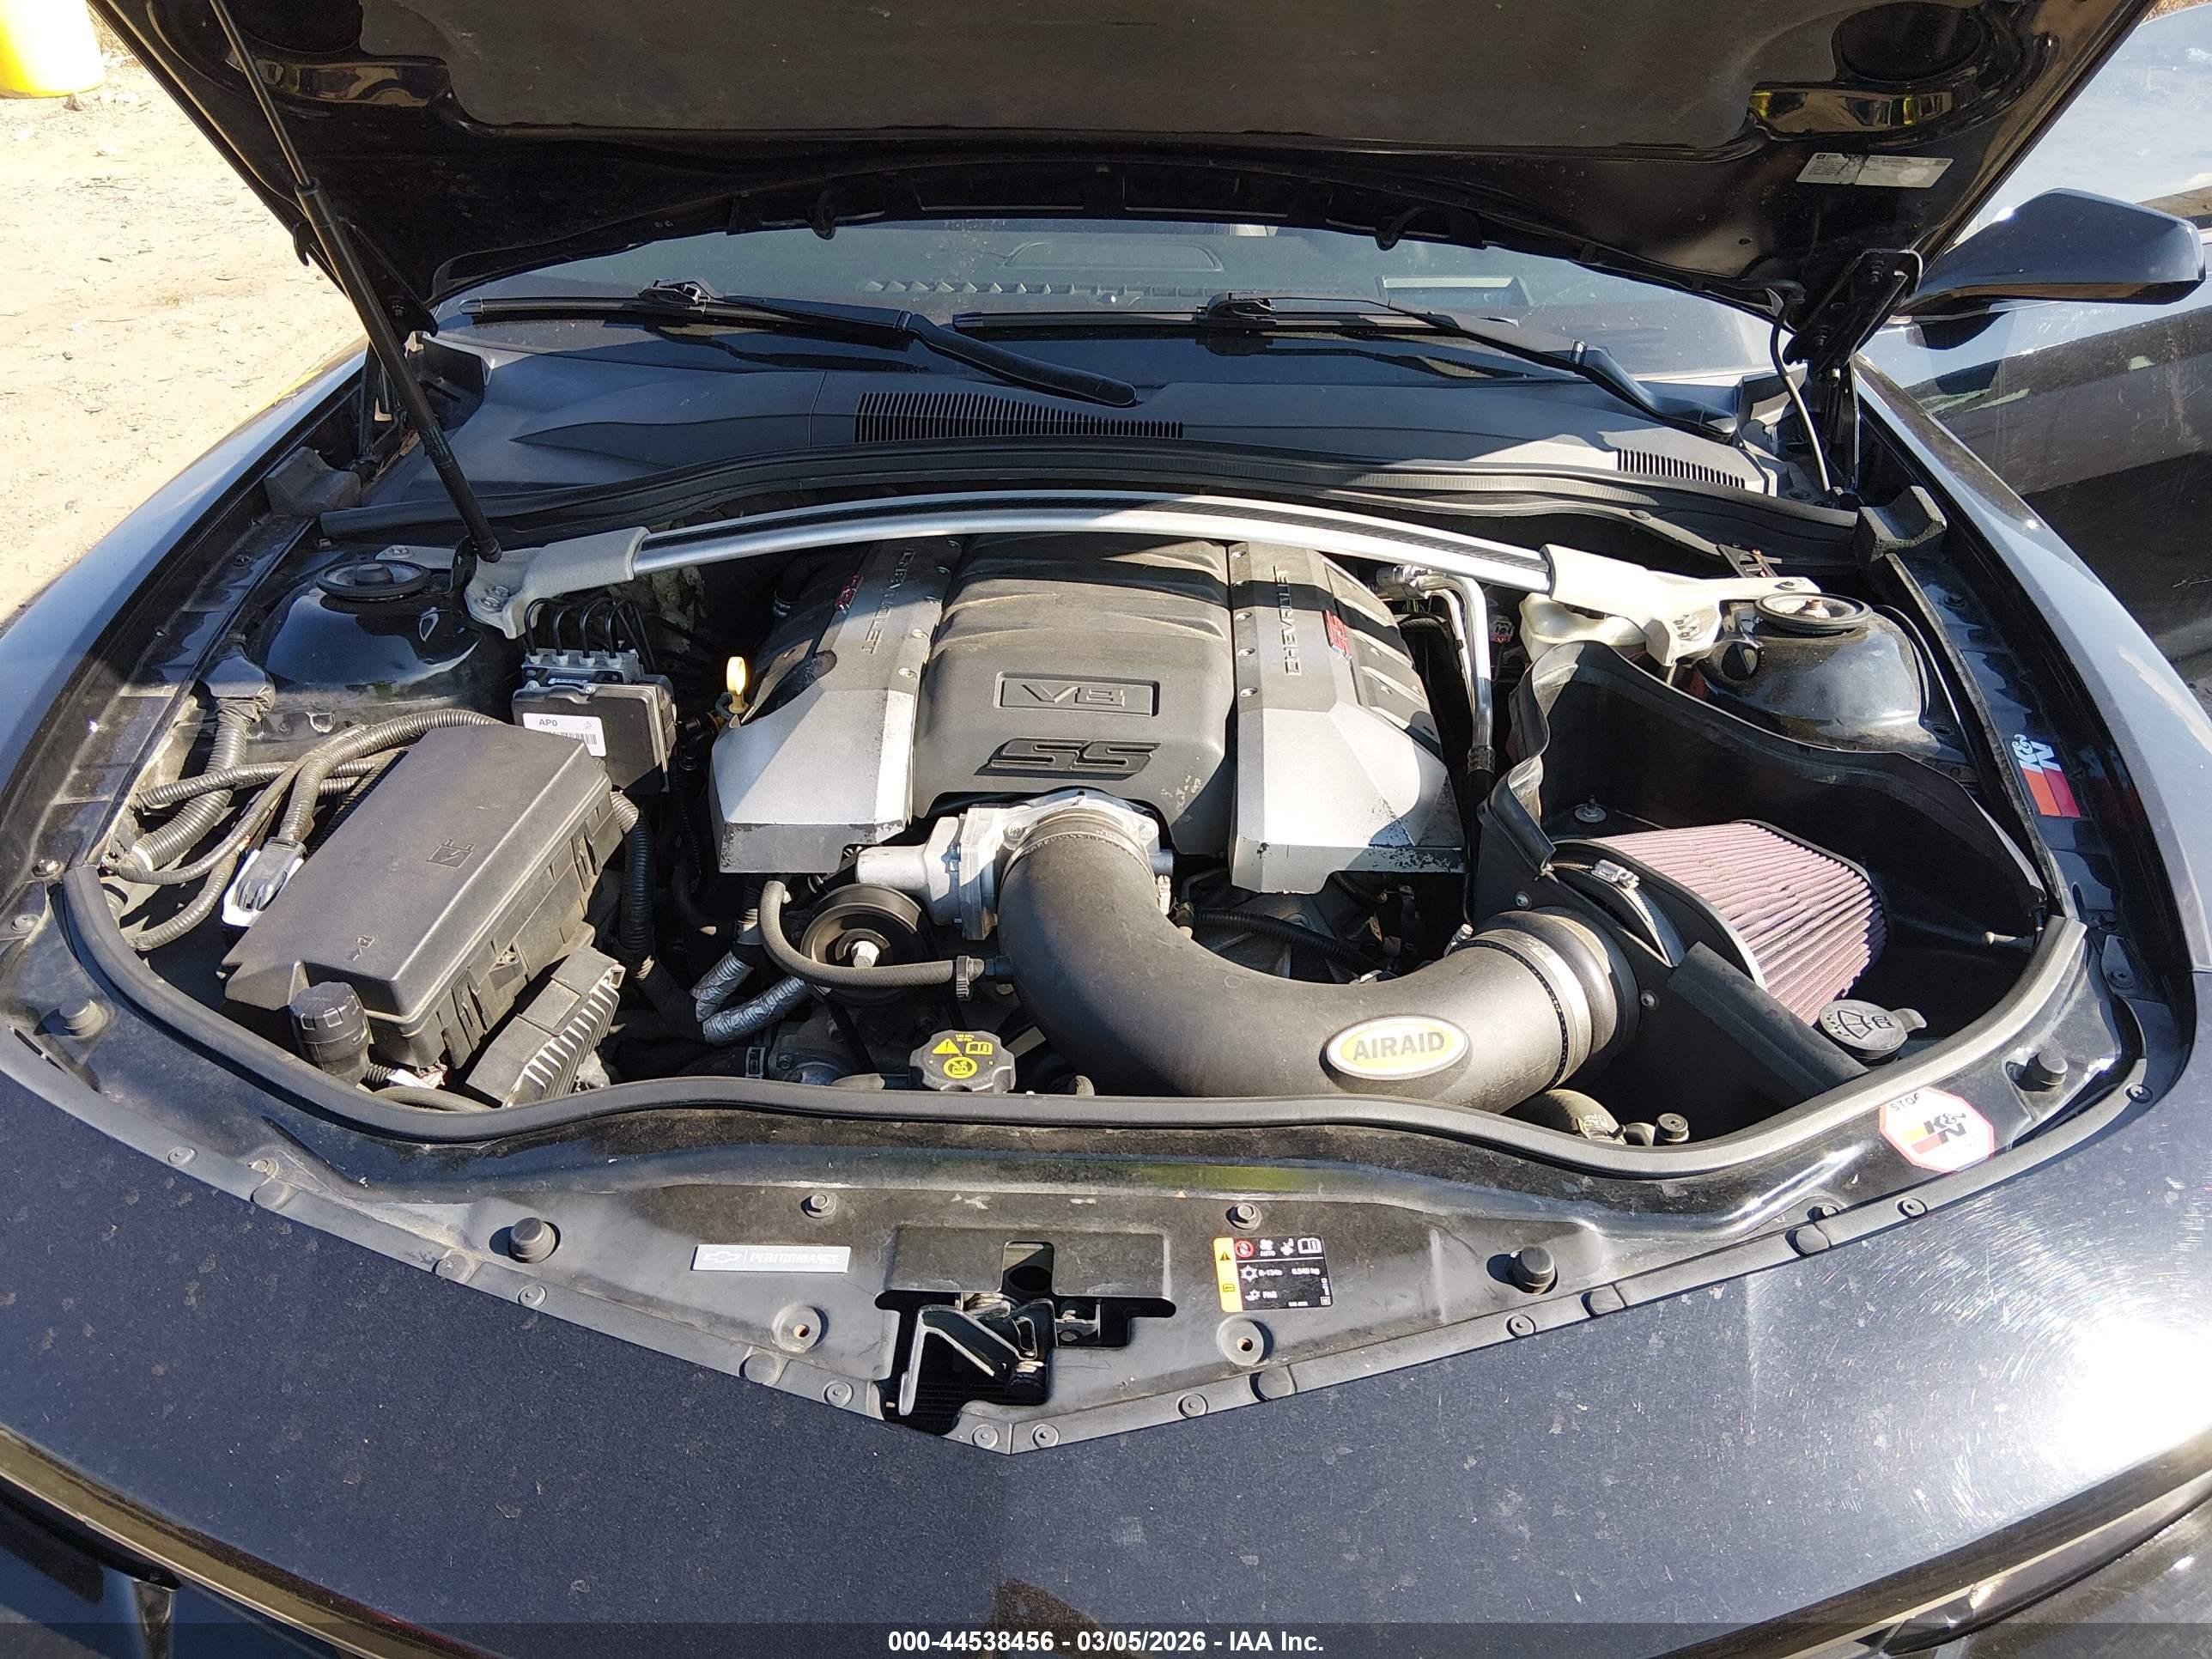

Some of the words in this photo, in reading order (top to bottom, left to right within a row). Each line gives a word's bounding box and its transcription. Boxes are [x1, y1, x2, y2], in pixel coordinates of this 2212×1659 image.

[1272, 565, 1302, 676] CHEVROLET
[1022, 684, 1126, 708] V8
[983, 736, 1162, 778] SS
[2011, 733, 2063, 774] K&N
[1353, 1030, 1445, 1060] AIRAID
[1923, 1112, 1967, 1145] K&N
